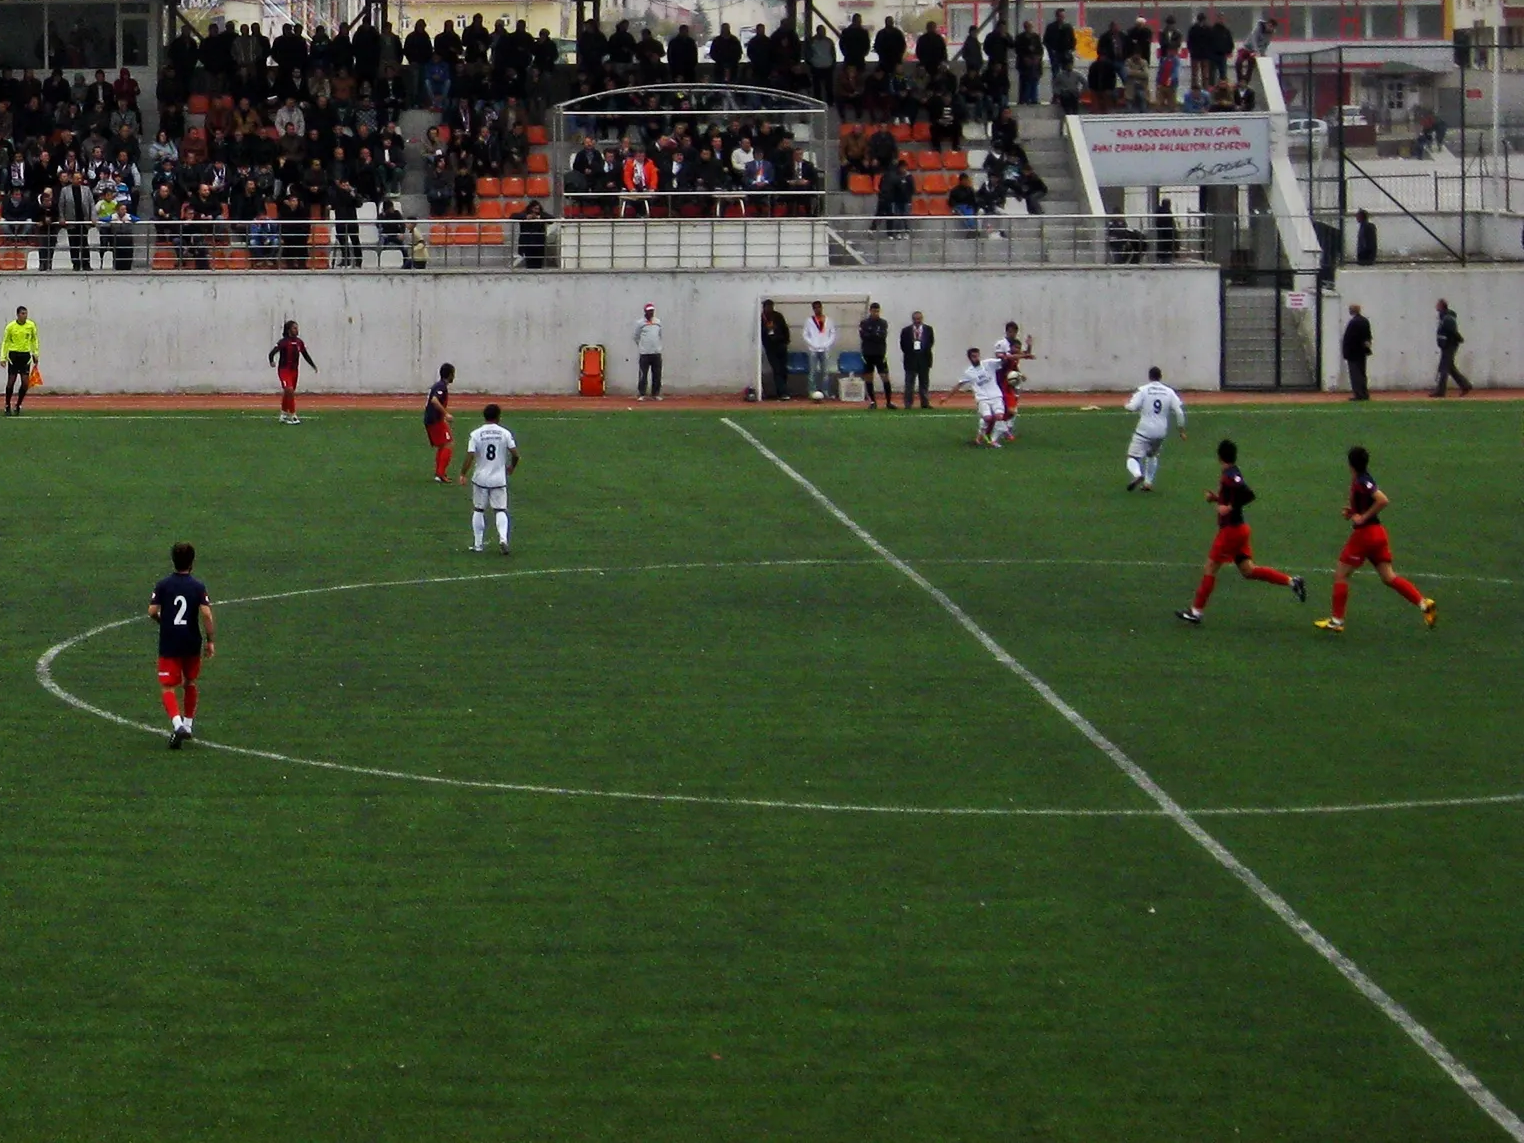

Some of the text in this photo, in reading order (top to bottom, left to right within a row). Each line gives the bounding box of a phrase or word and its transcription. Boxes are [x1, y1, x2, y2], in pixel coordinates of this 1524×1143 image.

[1153, 399, 1162, 414] 9
[486, 444, 496, 461] 8
[174, 595, 187, 625] 2
